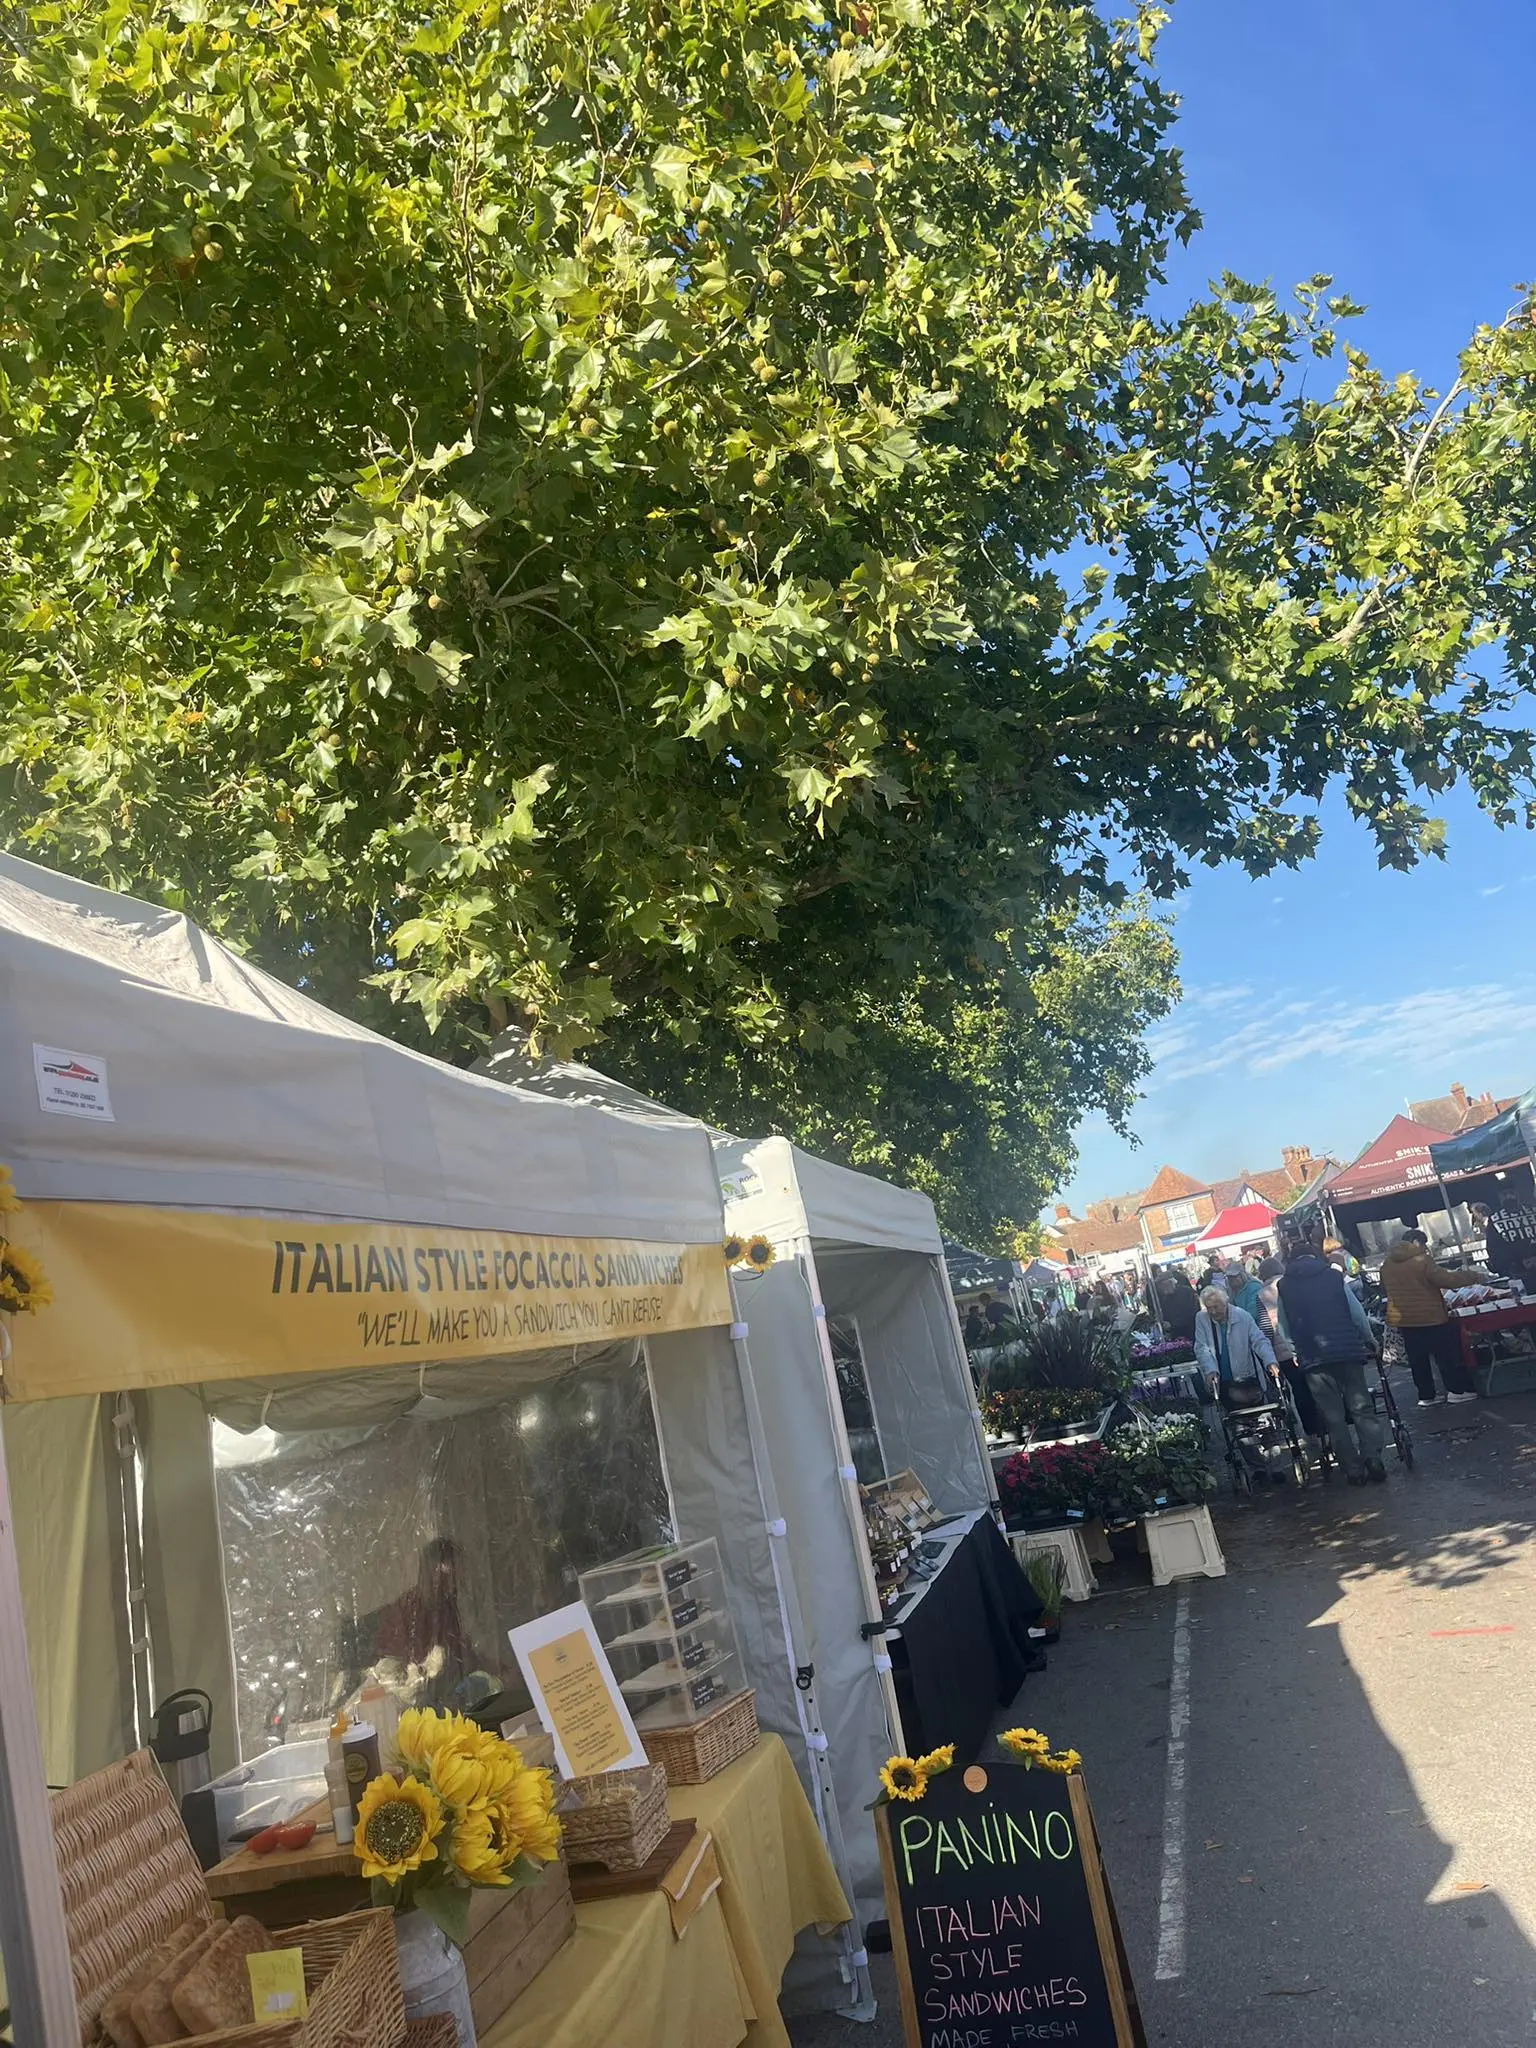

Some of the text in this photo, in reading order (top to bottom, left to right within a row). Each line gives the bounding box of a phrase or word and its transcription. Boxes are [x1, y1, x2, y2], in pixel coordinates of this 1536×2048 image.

[1370, 1182, 1405, 1195] AUTHENTIC
[1406, 1178, 1427, 1187] INDIAN
[1406, 1162, 1434, 1179] SNIK'
[272, 1241, 684, 1293] ITALIAN STYLE FOCACCIA SANDWICHES
[427, 1308, 469, 1345] MAKE
[473, 1305, 498, 1339] YOU
[503, 1303, 512, 1336] A
[513, 1300, 577, 1334] SANDWICH
[577, 1299, 599, 1327] YOU
[603, 1298, 631, 1326] CAN'T
[916, 1895, 1041, 1948] ITALIAN
[930, 1944, 1023, 1980] STYLE
[924, 1976, 1087, 2022] SANDWICHES
[931, 2019, 1079, 2048] MADE FRESH
